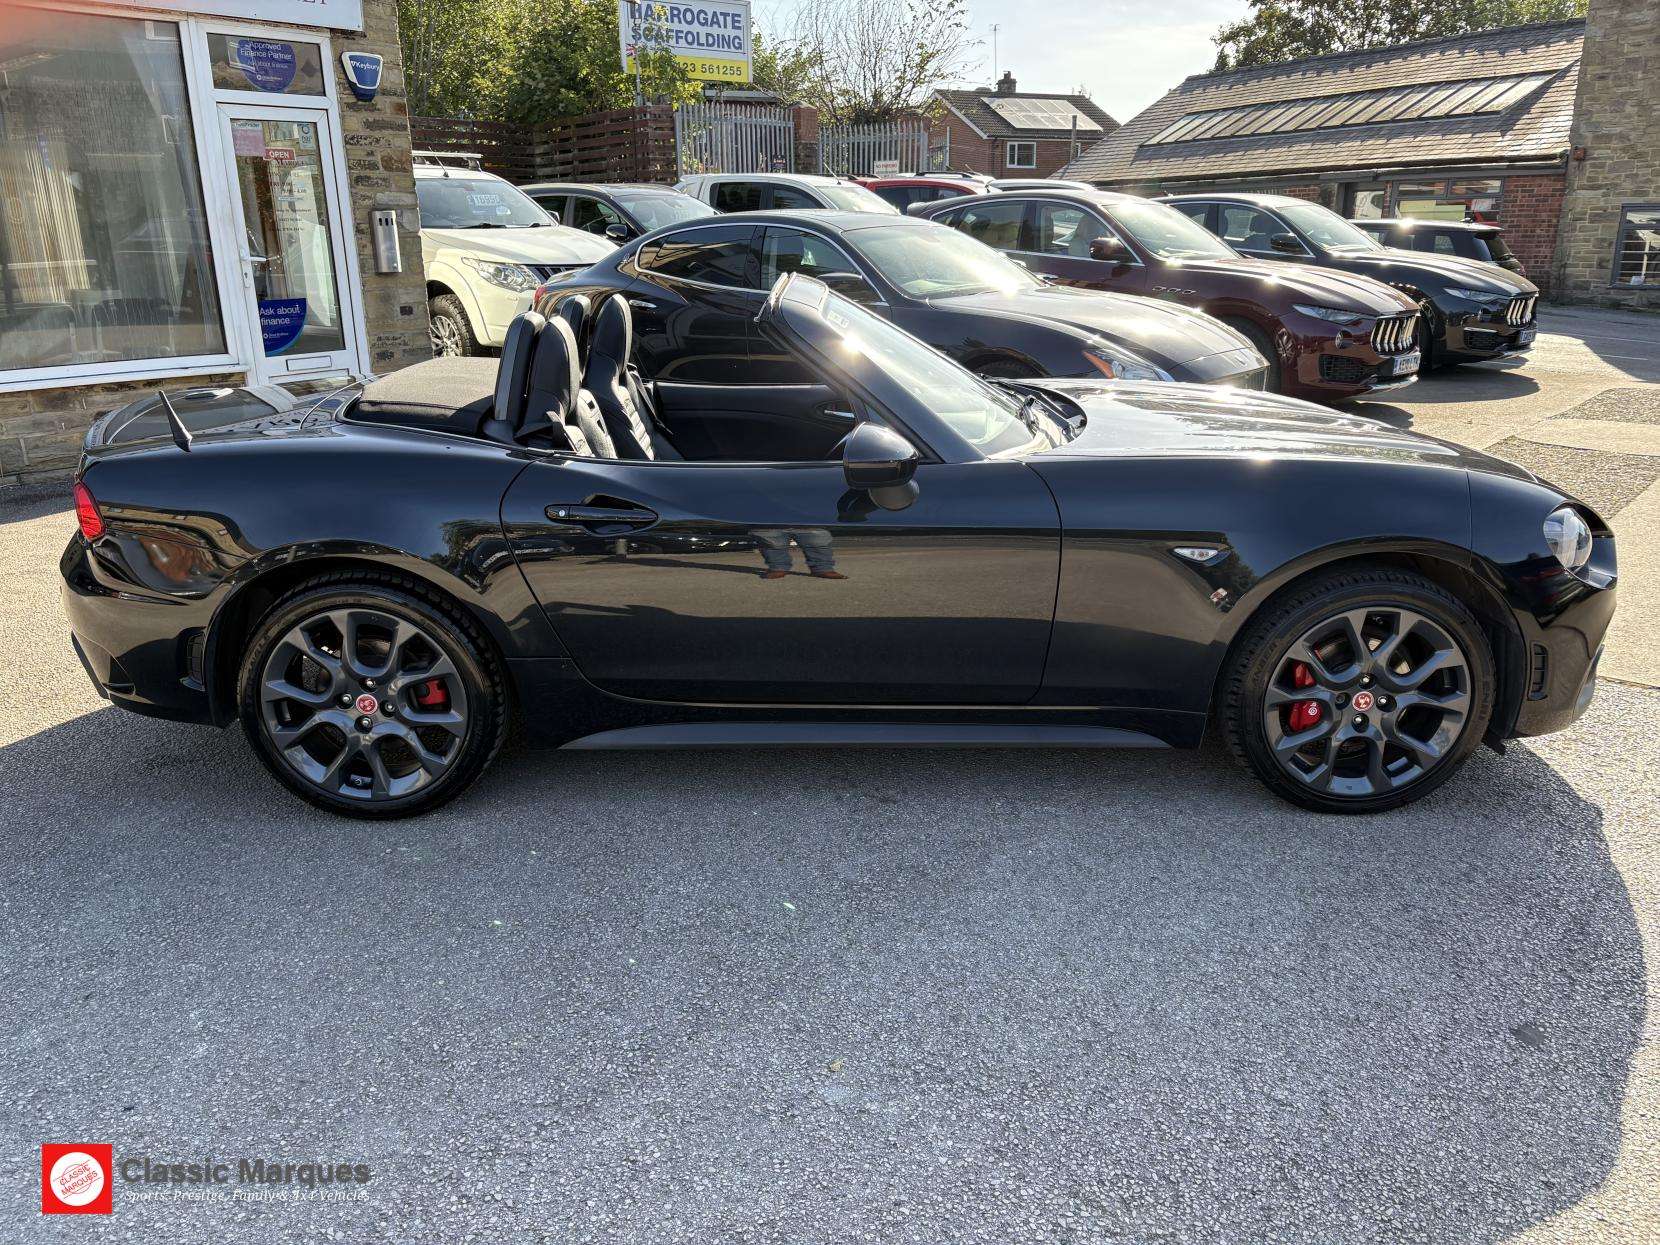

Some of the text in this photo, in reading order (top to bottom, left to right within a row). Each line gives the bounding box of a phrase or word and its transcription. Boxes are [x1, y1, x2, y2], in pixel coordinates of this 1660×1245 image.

[240, 49, 292, 60] Finance Partner
[700, 63, 742, 76] 561255
[268, 150, 290, 159] OPEN
[260, 304, 301, 316] Ask about
[260, 317, 291, 326] finance
